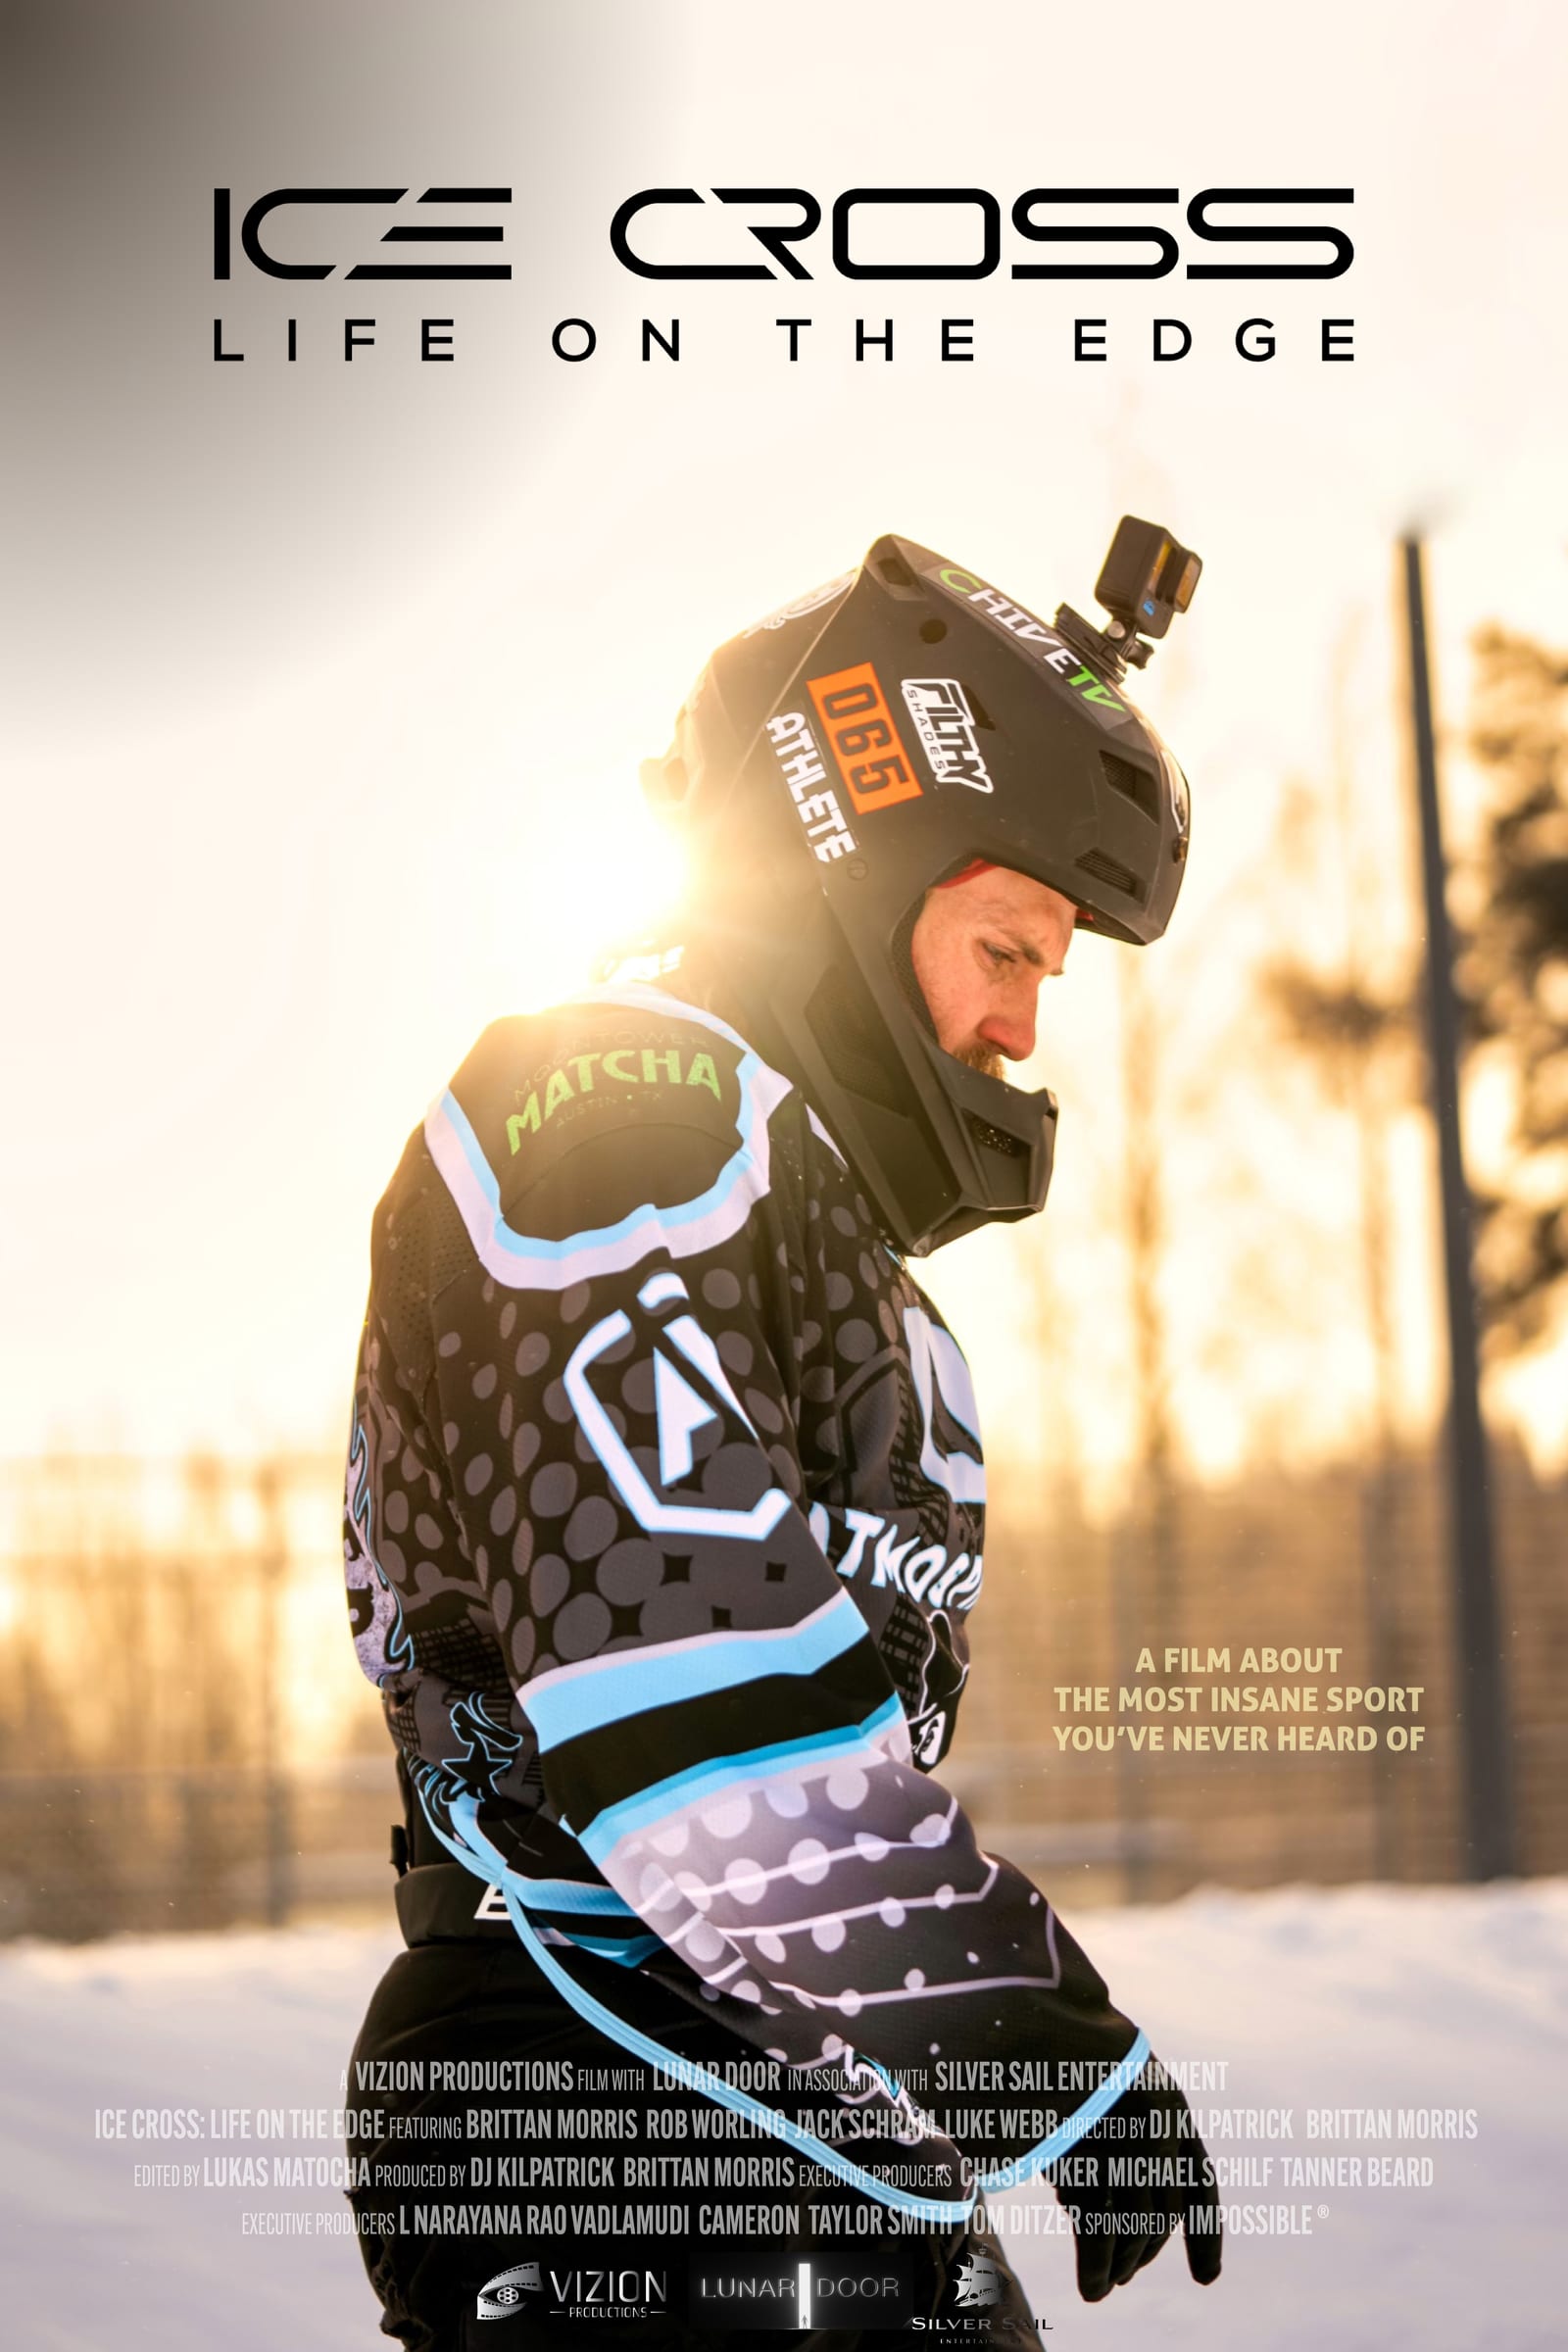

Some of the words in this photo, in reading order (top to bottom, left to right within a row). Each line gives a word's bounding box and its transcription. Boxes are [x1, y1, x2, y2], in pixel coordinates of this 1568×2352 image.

[904, 679, 993, 792] FILTHY
[906, 689, 947, 770] SHADES
[766, 711, 857, 863] ATHLETE
[506, 1048, 722, 1156] MATCHA
